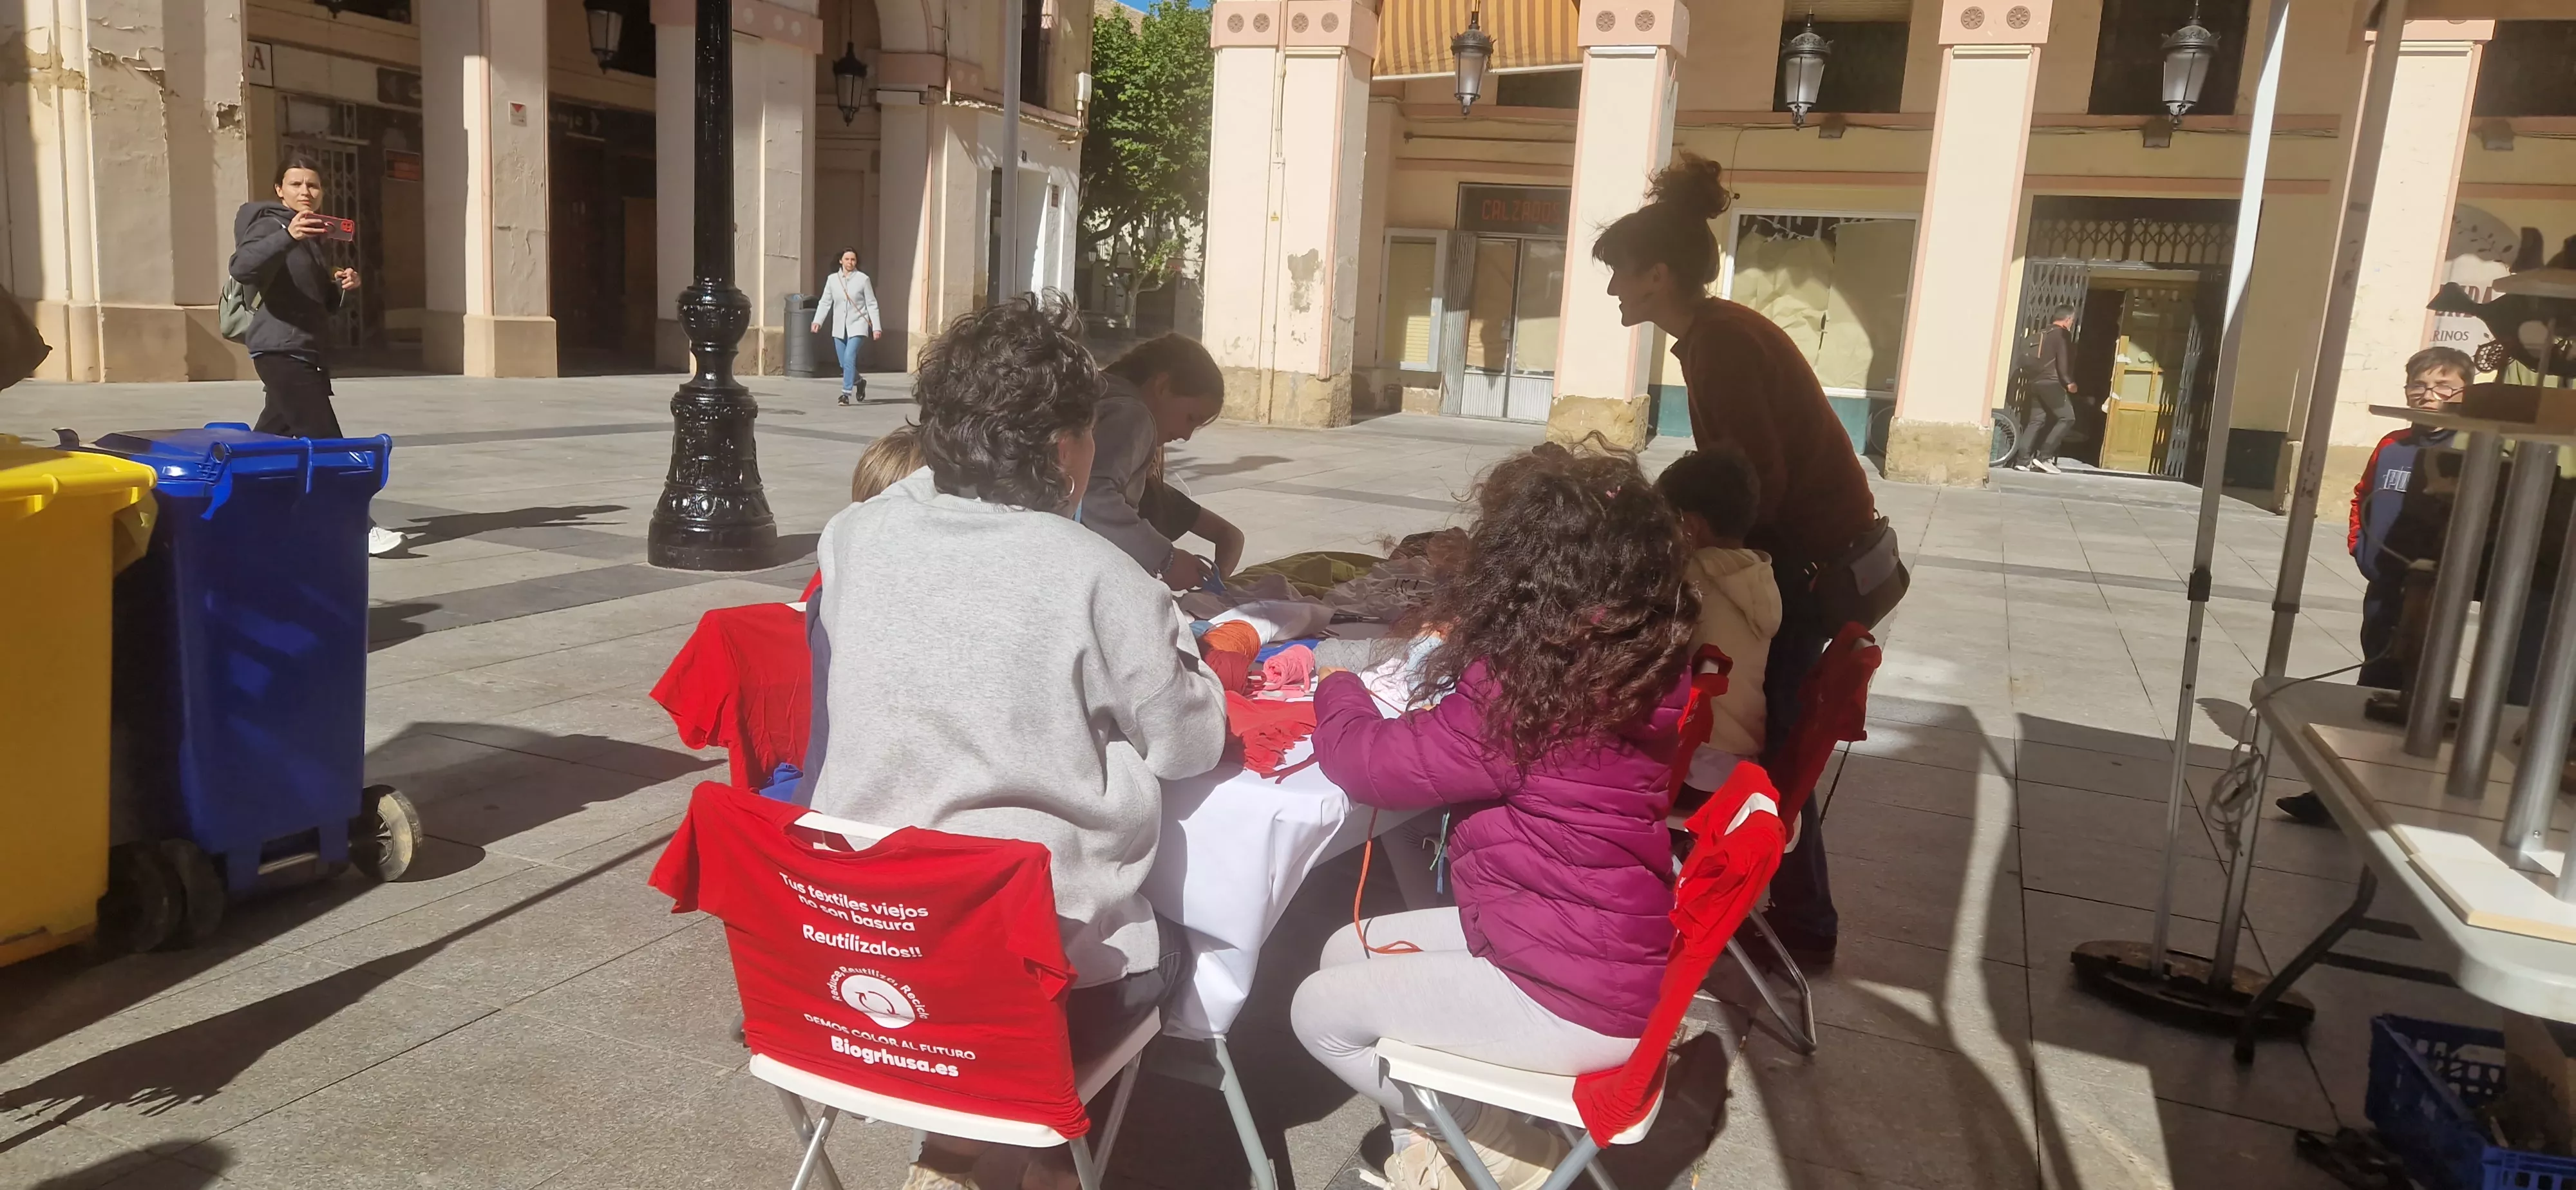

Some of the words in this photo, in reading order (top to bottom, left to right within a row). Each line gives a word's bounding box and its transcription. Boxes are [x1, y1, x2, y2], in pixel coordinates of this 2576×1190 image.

[1482, 199, 1562, 223] CALZADOS
[2430, 330, 2470, 341] RINOS
[779, 872, 806, 893] Tus
[808, 885, 869, 912] textiles
[871, 902, 929, 920] viejos
[798, 894, 818, 909] no
[819, 903, 849, 921] son
[850, 910, 915, 931] basura
[802, 924, 923, 958] Reutilizalos!!
[804, 1013, 849, 1034] DEMOS
[851, 1029, 900, 1048] COLOR
[901, 1040, 918, 1051] AL
[919, 1043, 976, 1061] FUTURO
[831, 1035, 959, 1077] Biogrhusa.es
